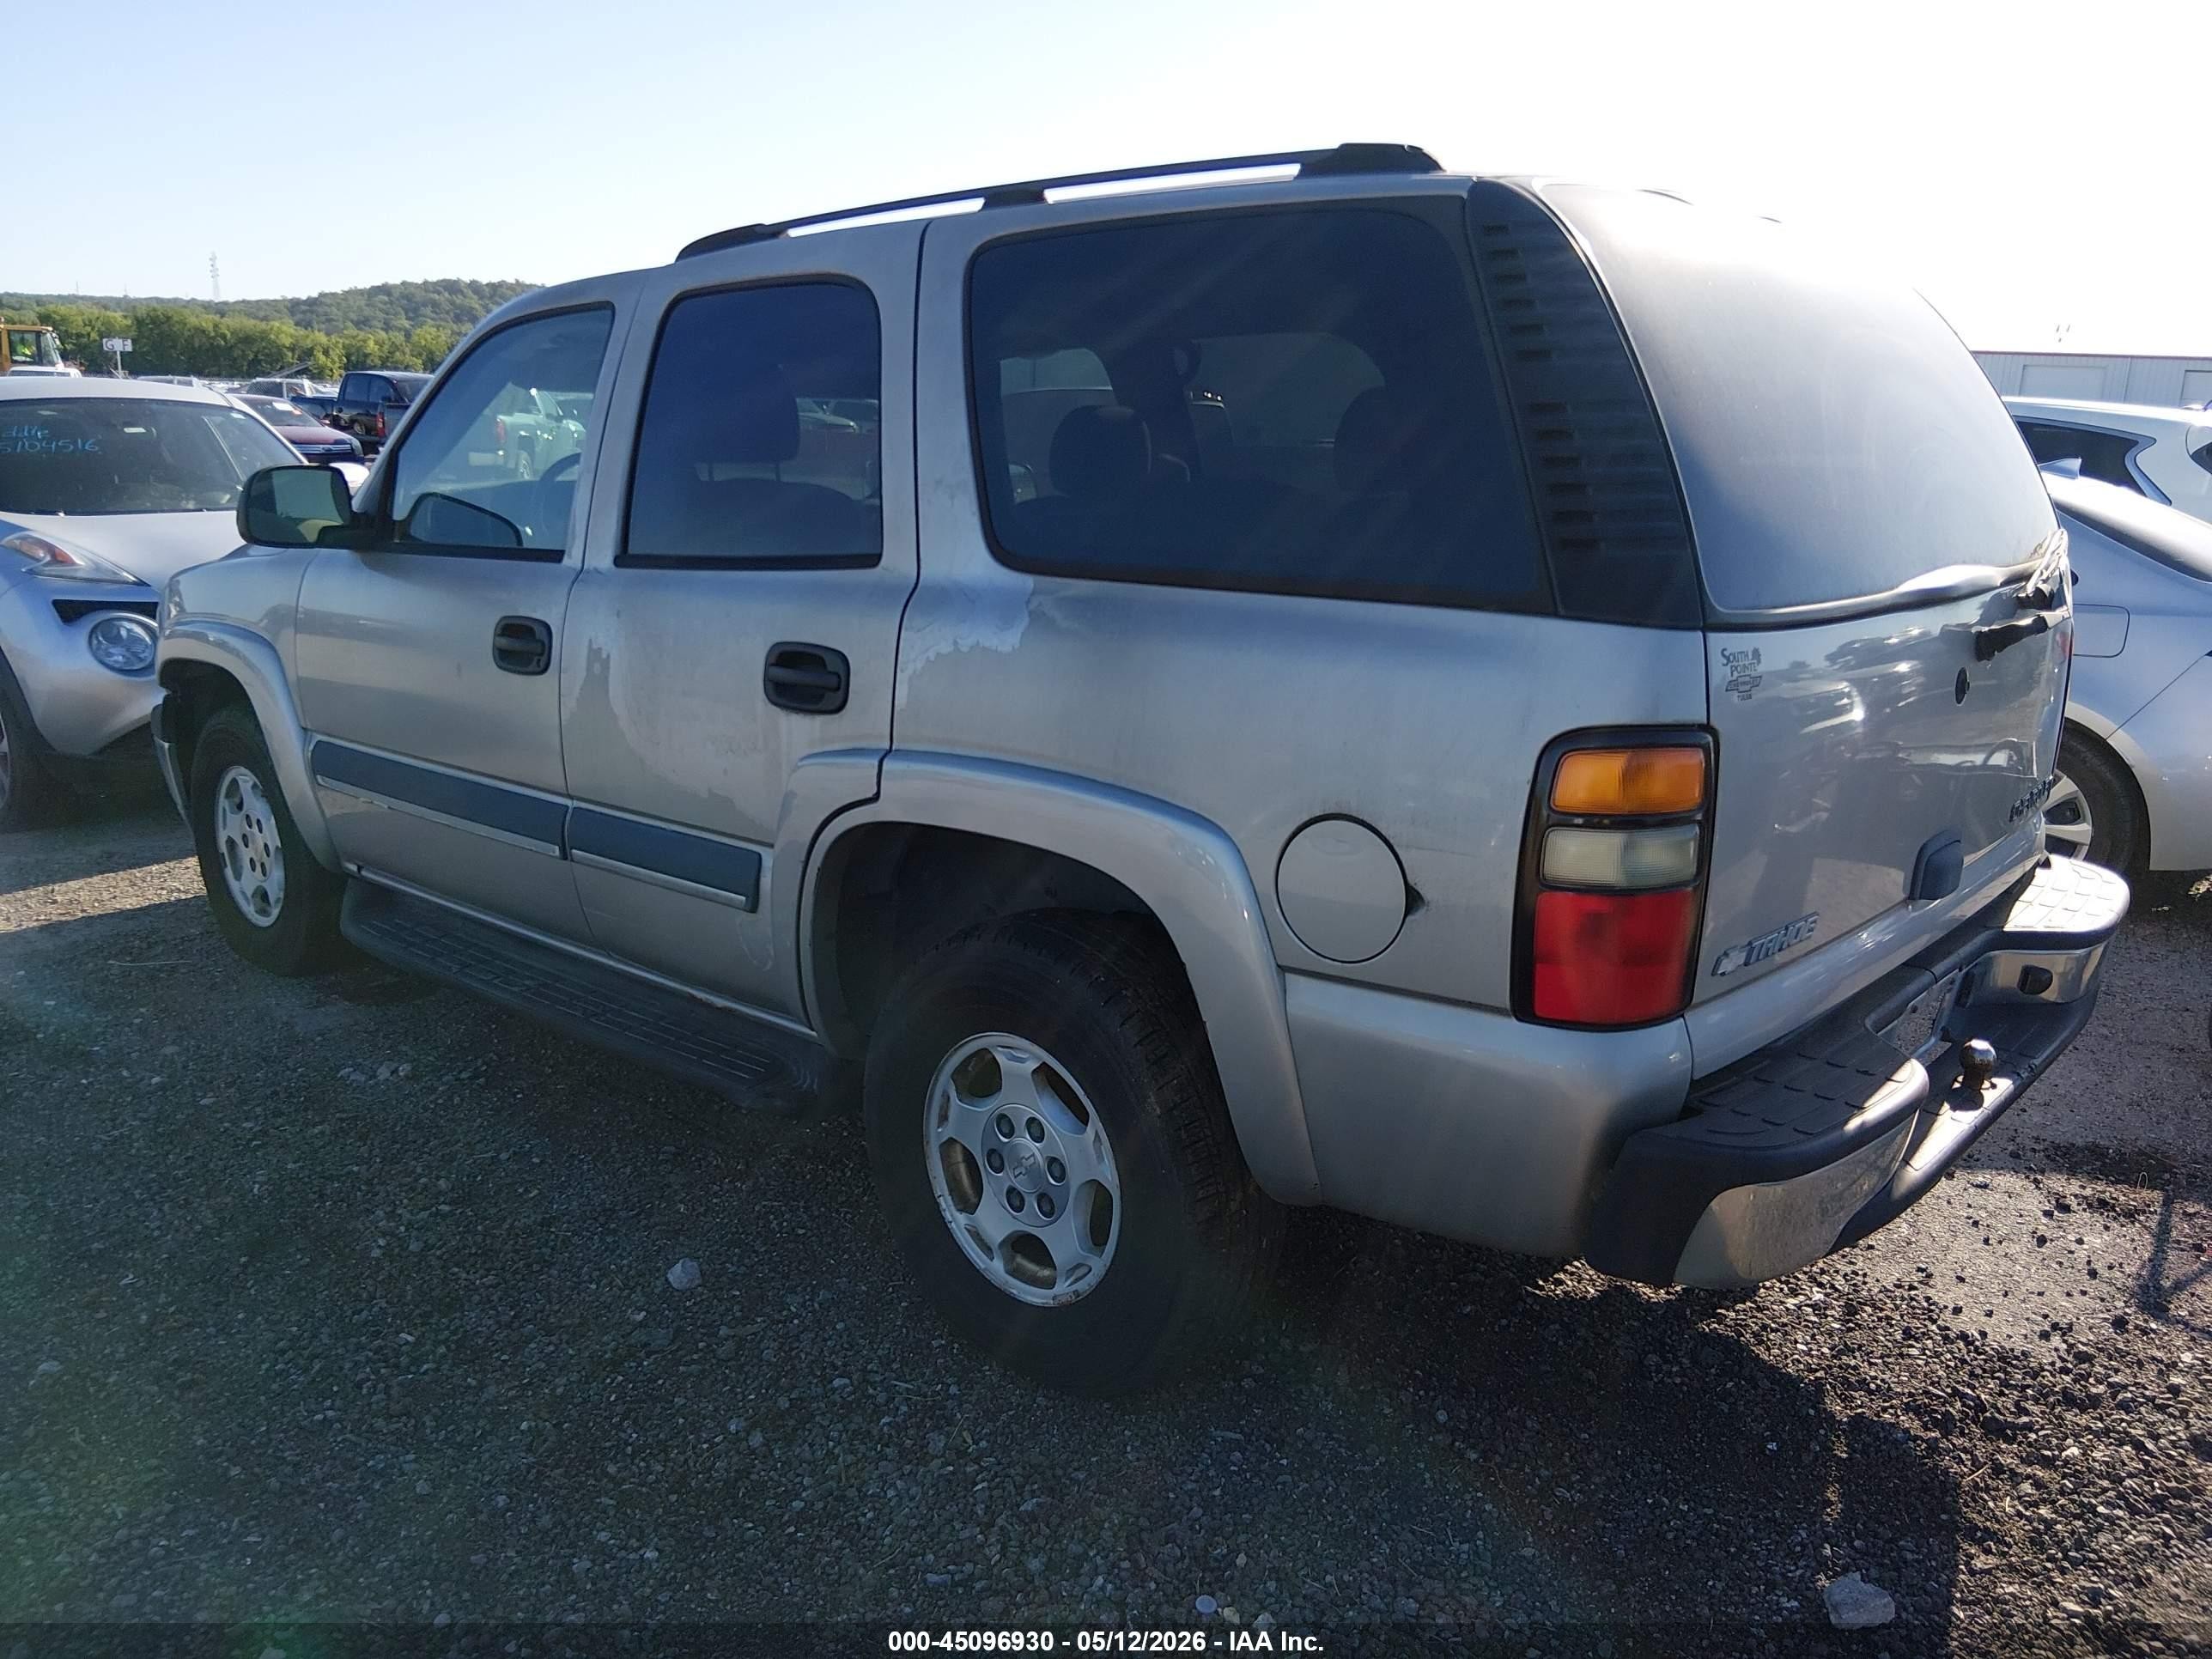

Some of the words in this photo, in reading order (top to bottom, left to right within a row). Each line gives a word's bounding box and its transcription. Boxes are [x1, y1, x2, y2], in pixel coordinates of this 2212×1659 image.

[105, 338, 115, 350] G
[122, 339, 130, 350] F
[1730, 661, 1758, 678] POINTE
[1745, 912, 1820, 966] TAHOE
